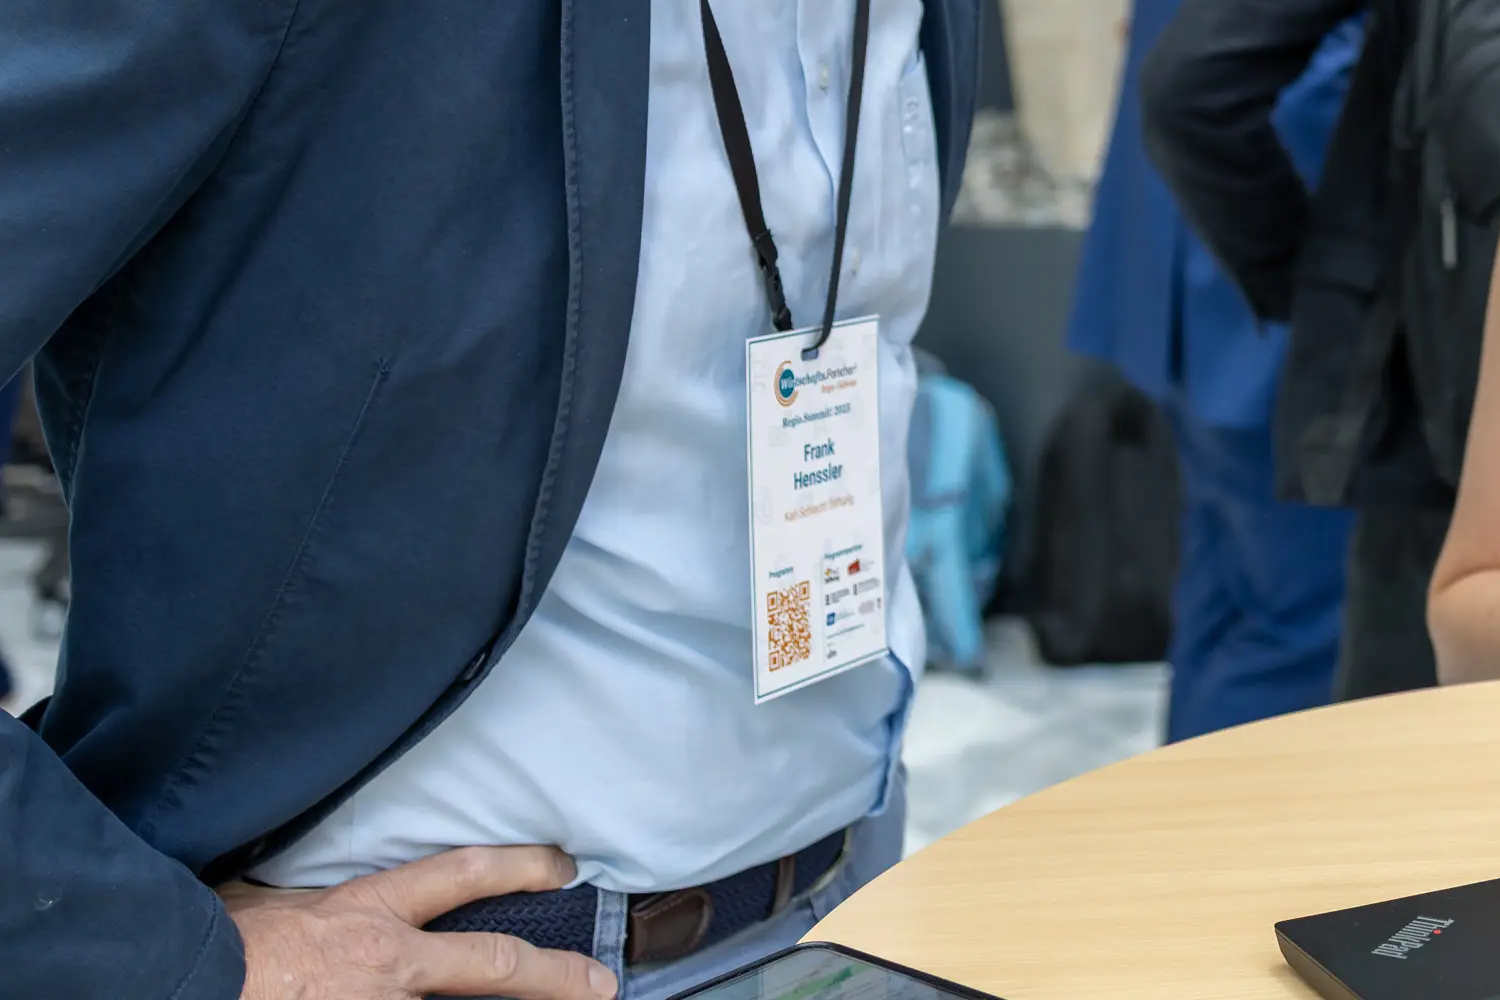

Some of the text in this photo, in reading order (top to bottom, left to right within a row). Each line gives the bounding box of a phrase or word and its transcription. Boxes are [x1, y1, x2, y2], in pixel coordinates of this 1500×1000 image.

[804, 437, 835, 462] Frank
[793, 462, 843, 490] Henssler
[1371, 915, 1454, 959] ThinkPad
